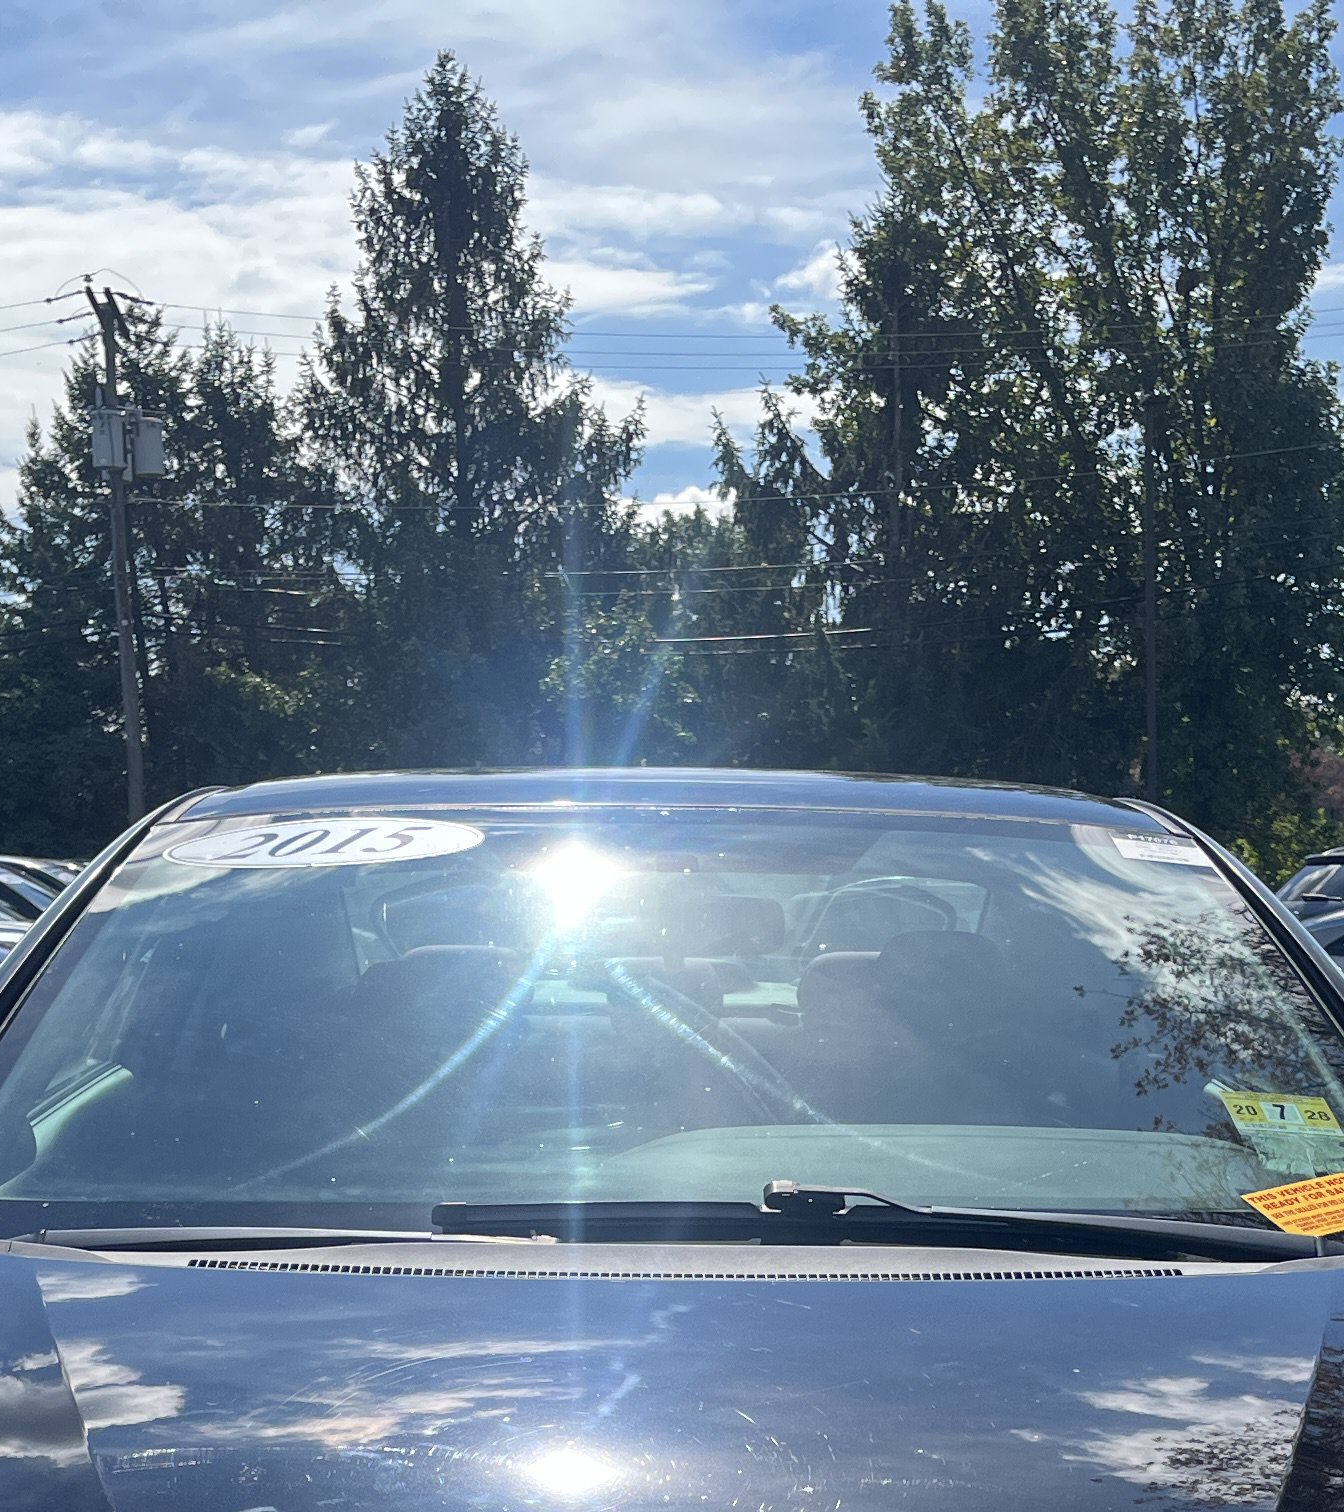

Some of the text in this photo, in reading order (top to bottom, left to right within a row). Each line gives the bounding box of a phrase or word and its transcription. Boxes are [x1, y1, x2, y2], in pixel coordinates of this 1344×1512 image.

[208, 826, 434, 861] 2015
[1232, 1104, 1258, 1116] 20
[1272, 1103, 1286, 1120] 7
[1304, 1109, 1331, 1121] 28
[1248, 1191, 1277, 1204] THIS
[1278, 1181, 1326, 1198] VEHICLE
[1262, 1197, 1301, 1211] READY
[1302, 1191, 1325, 1203] FOR
